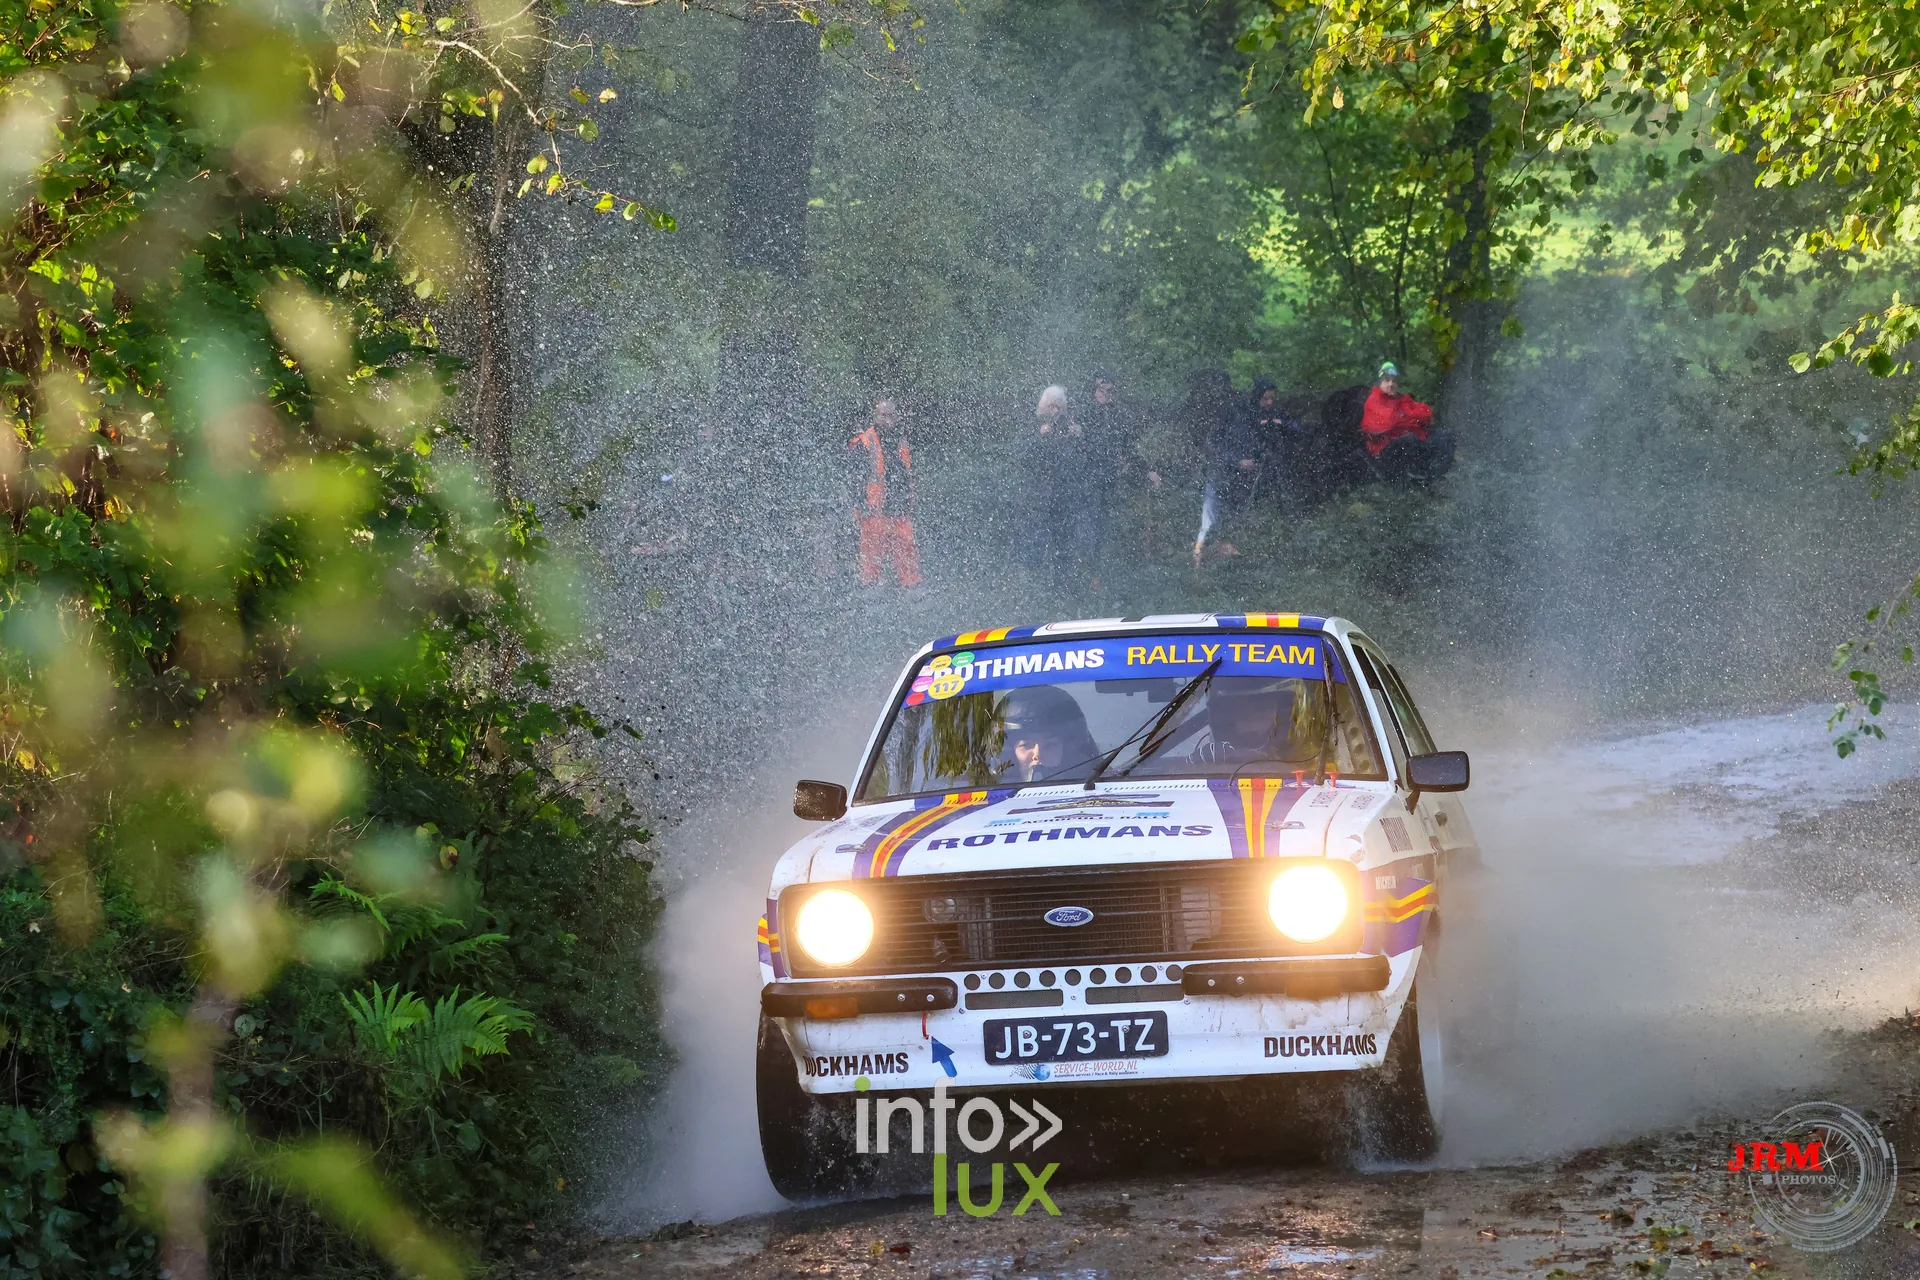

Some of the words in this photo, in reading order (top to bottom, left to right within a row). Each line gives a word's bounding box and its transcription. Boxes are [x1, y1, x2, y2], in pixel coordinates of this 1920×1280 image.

[1127, 643, 1221, 666] RALLY
[1228, 643, 1316, 666] TEAM
[933, 680, 960, 693] 117
[926, 825, 1214, 851] ROTHMANS
[1055, 910, 1082, 922] Ford
[995, 1018, 1156, 1060] JB-73-TZ
[1263, 1033, 1378, 1058] DUCKHAMS
[802, 1052, 910, 1078] DUCKHAMS
[1053, 1060, 1138, 1074] SERVICE-WORLD.NL
